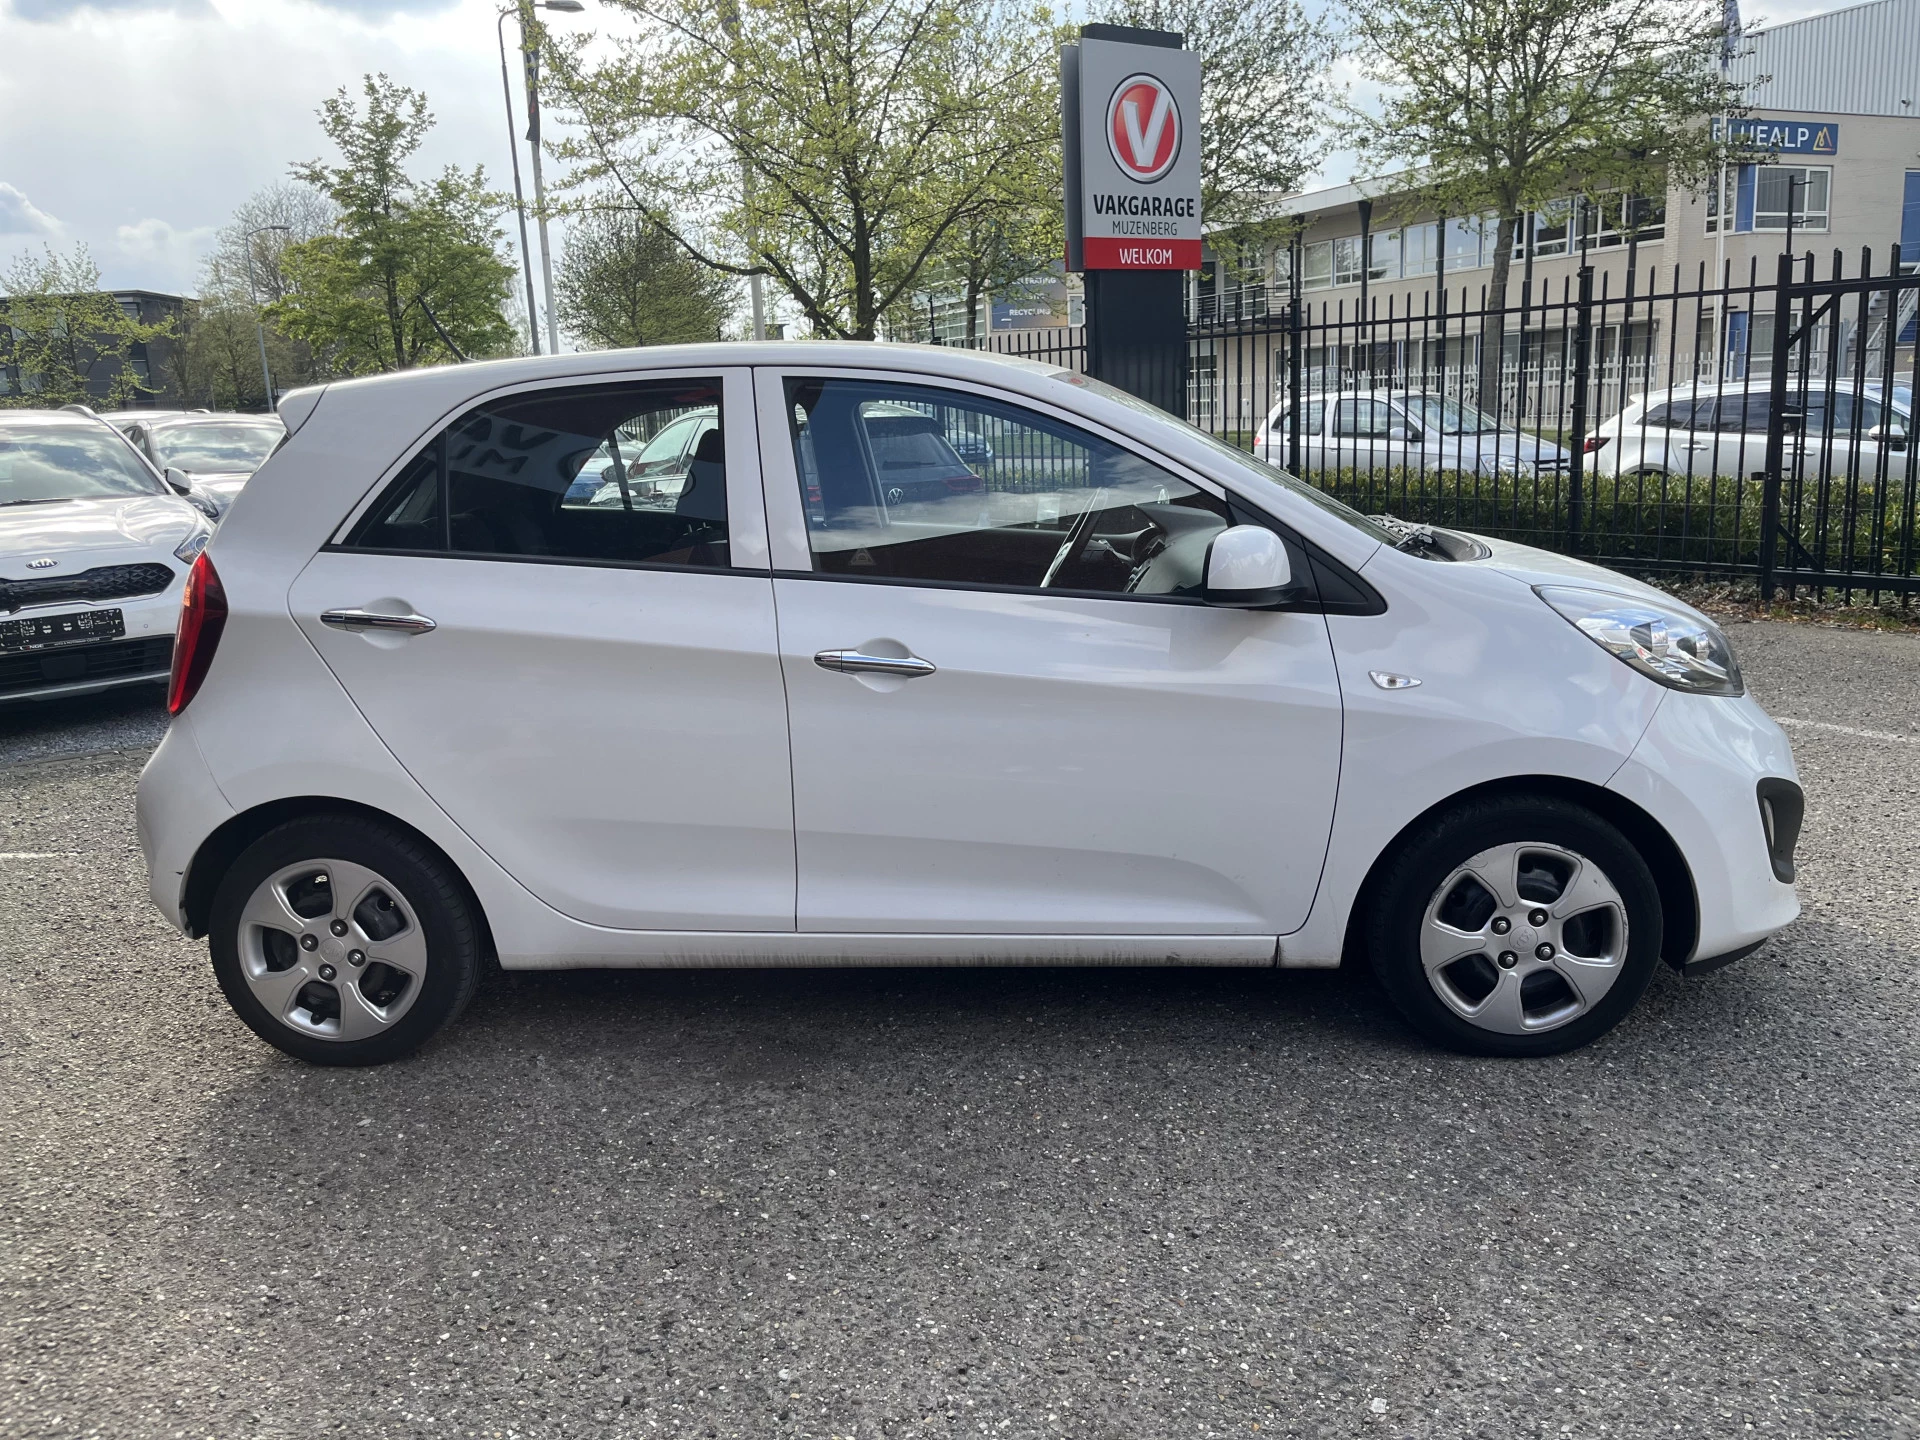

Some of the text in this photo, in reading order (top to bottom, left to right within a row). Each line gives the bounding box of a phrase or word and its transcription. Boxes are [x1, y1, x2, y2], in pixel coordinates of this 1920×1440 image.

[1093, 194, 1195, 218] VAKGARAGE
[1112, 221, 1177, 236] MUZENBERG
[1119, 248, 1173, 265] WELKOM
[30, 558, 55, 568] KIA
